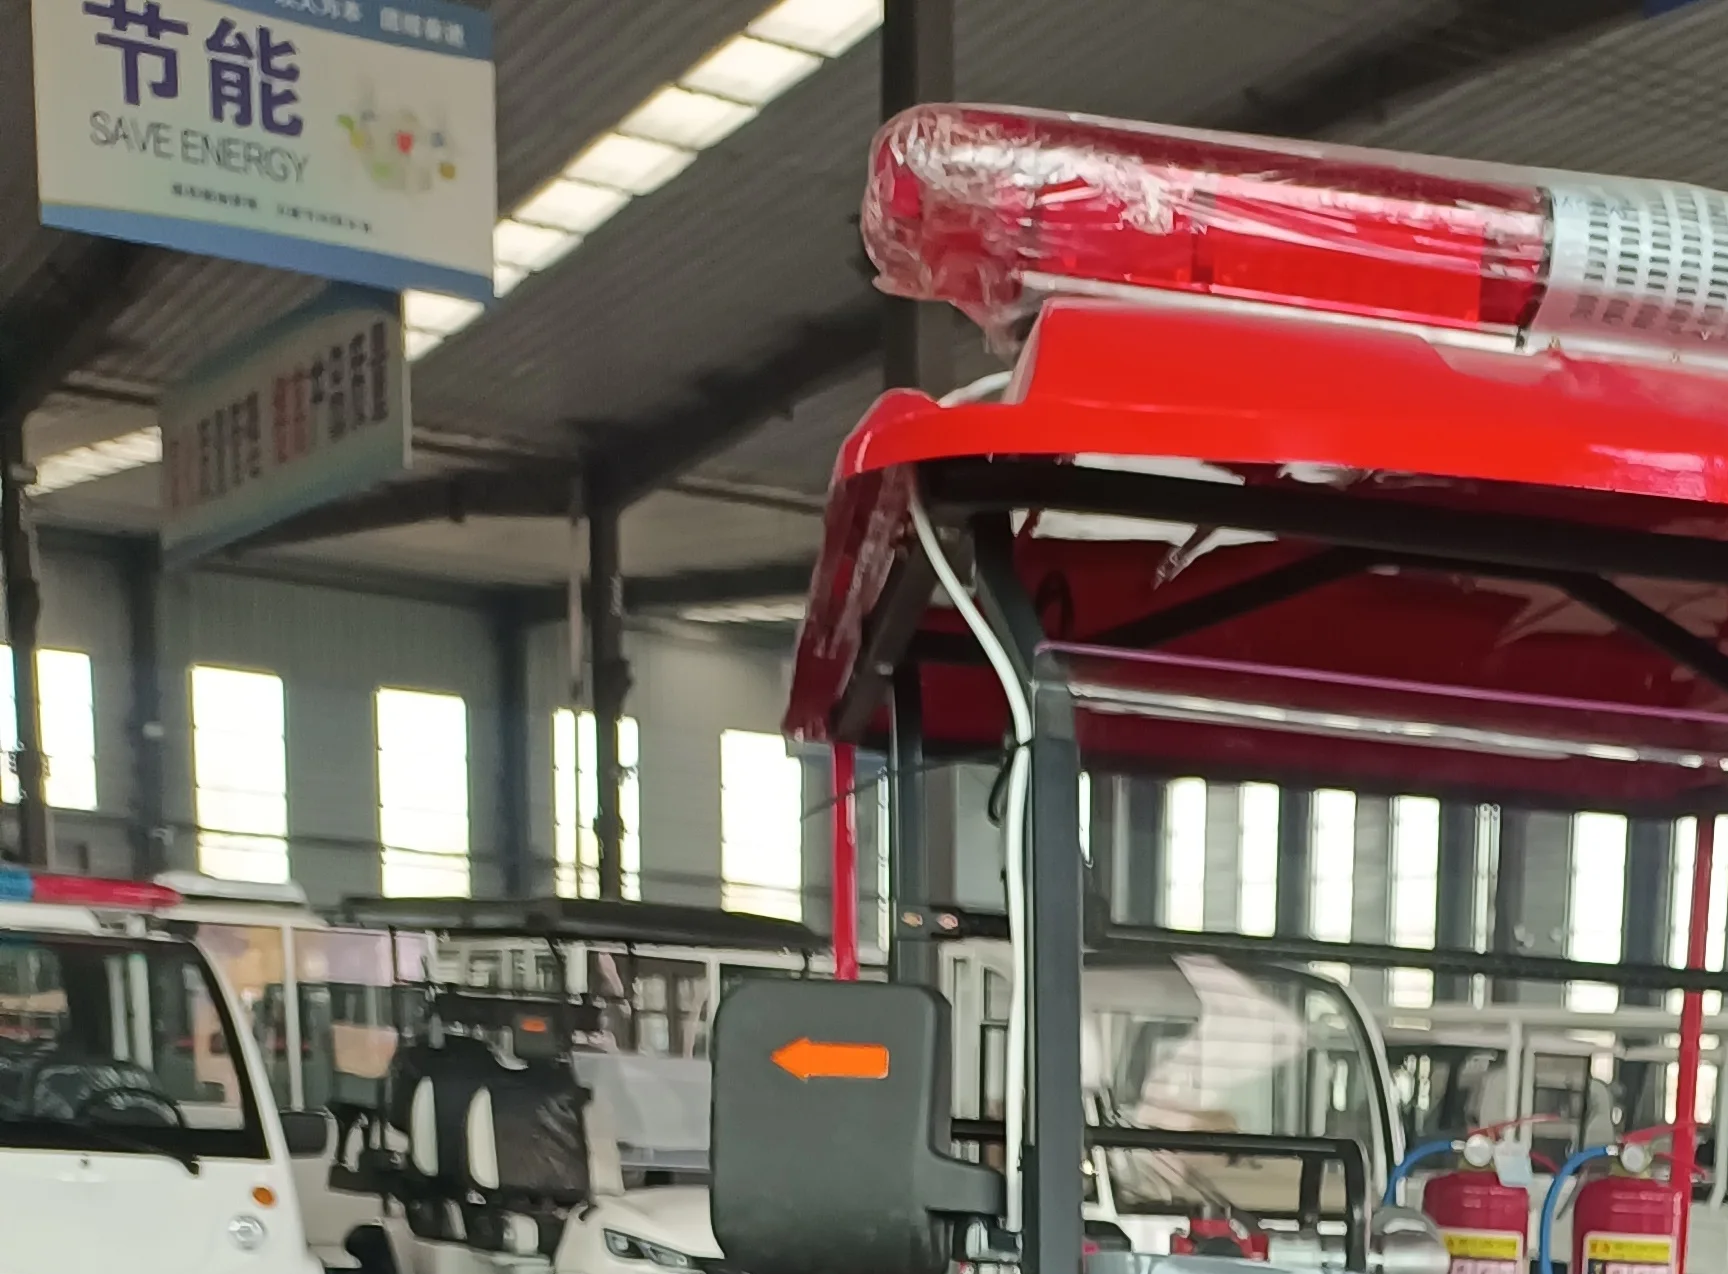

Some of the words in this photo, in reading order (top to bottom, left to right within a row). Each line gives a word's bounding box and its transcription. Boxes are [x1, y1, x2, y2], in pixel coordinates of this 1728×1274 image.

[82, 0, 304, 136] 节能
[89, 110, 174, 159] SAVE
[180, 128, 310, 183] ENERGY
